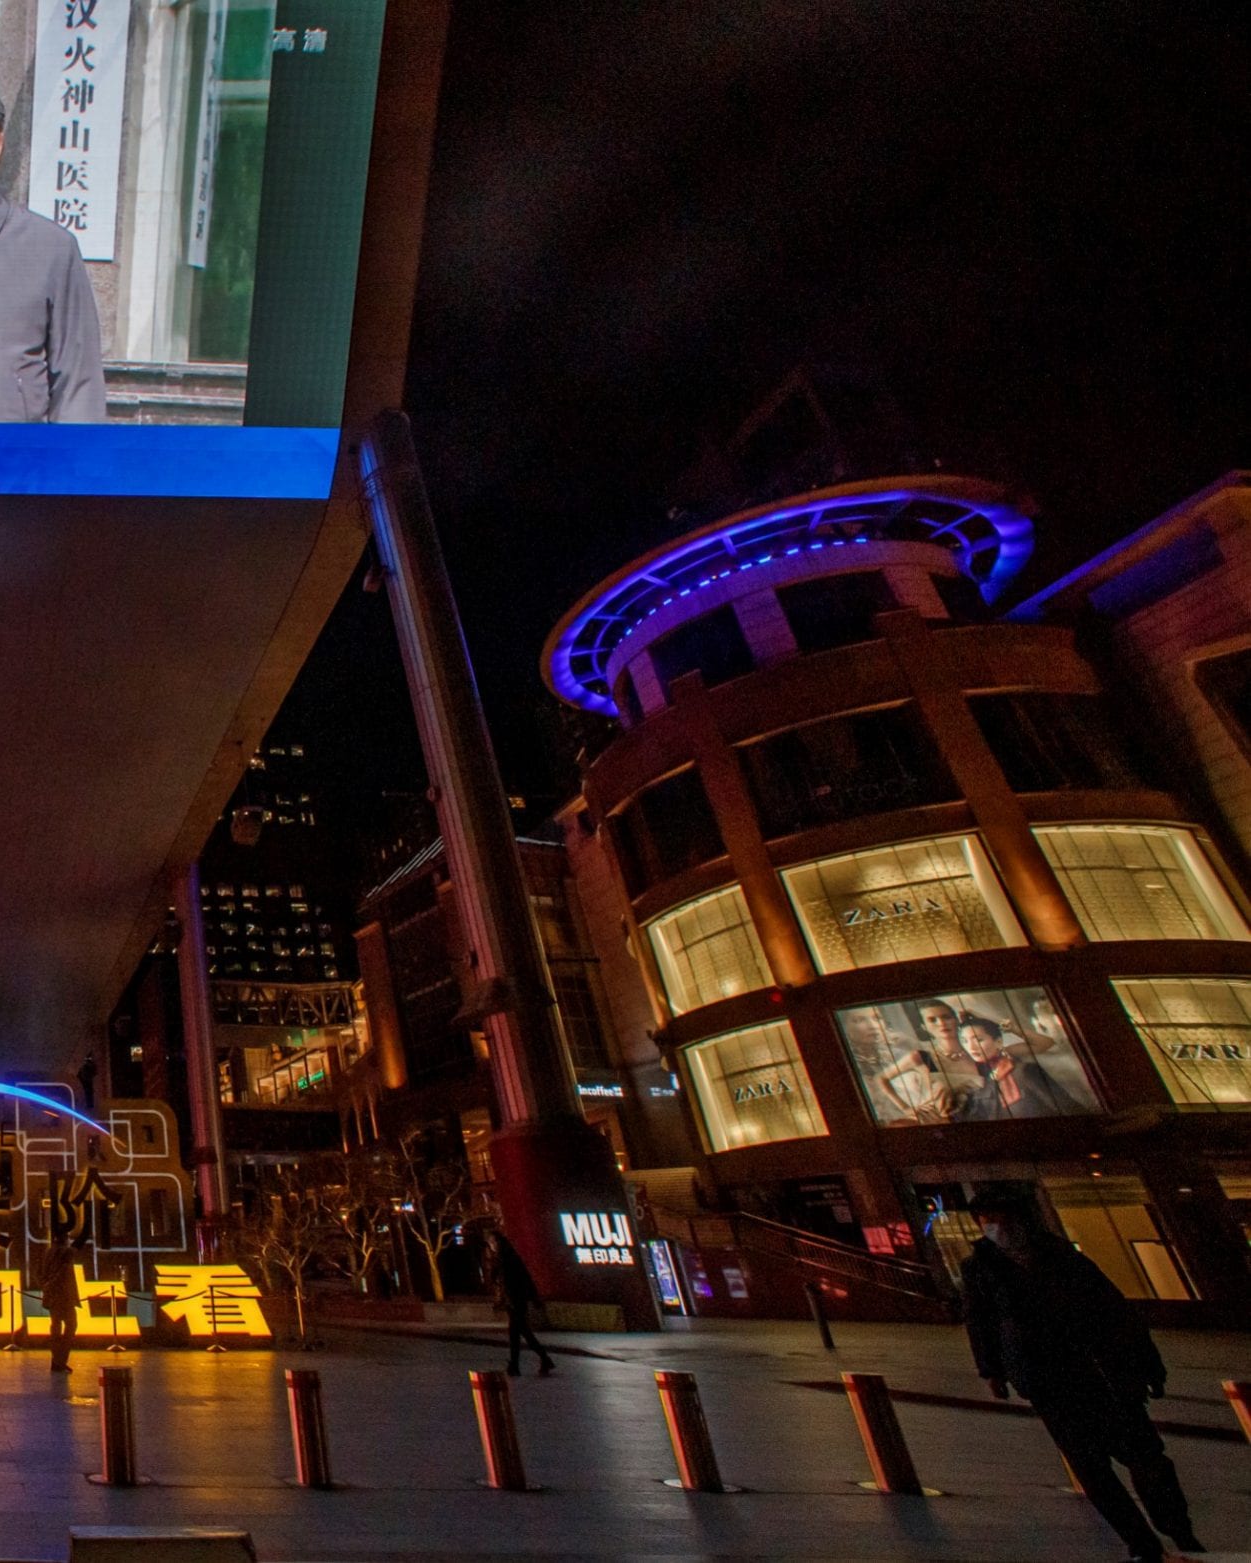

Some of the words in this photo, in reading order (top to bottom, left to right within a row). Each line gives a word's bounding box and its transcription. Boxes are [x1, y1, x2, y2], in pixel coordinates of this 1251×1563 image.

[53, 0, 97, 231] 汉火神山医院
[843, 897, 942, 926] ZARA
[734, 1079, 792, 1104] ZARA
[560, 1212, 634, 1246] MUJI
[575, 1246, 635, 1265] 無印良品
